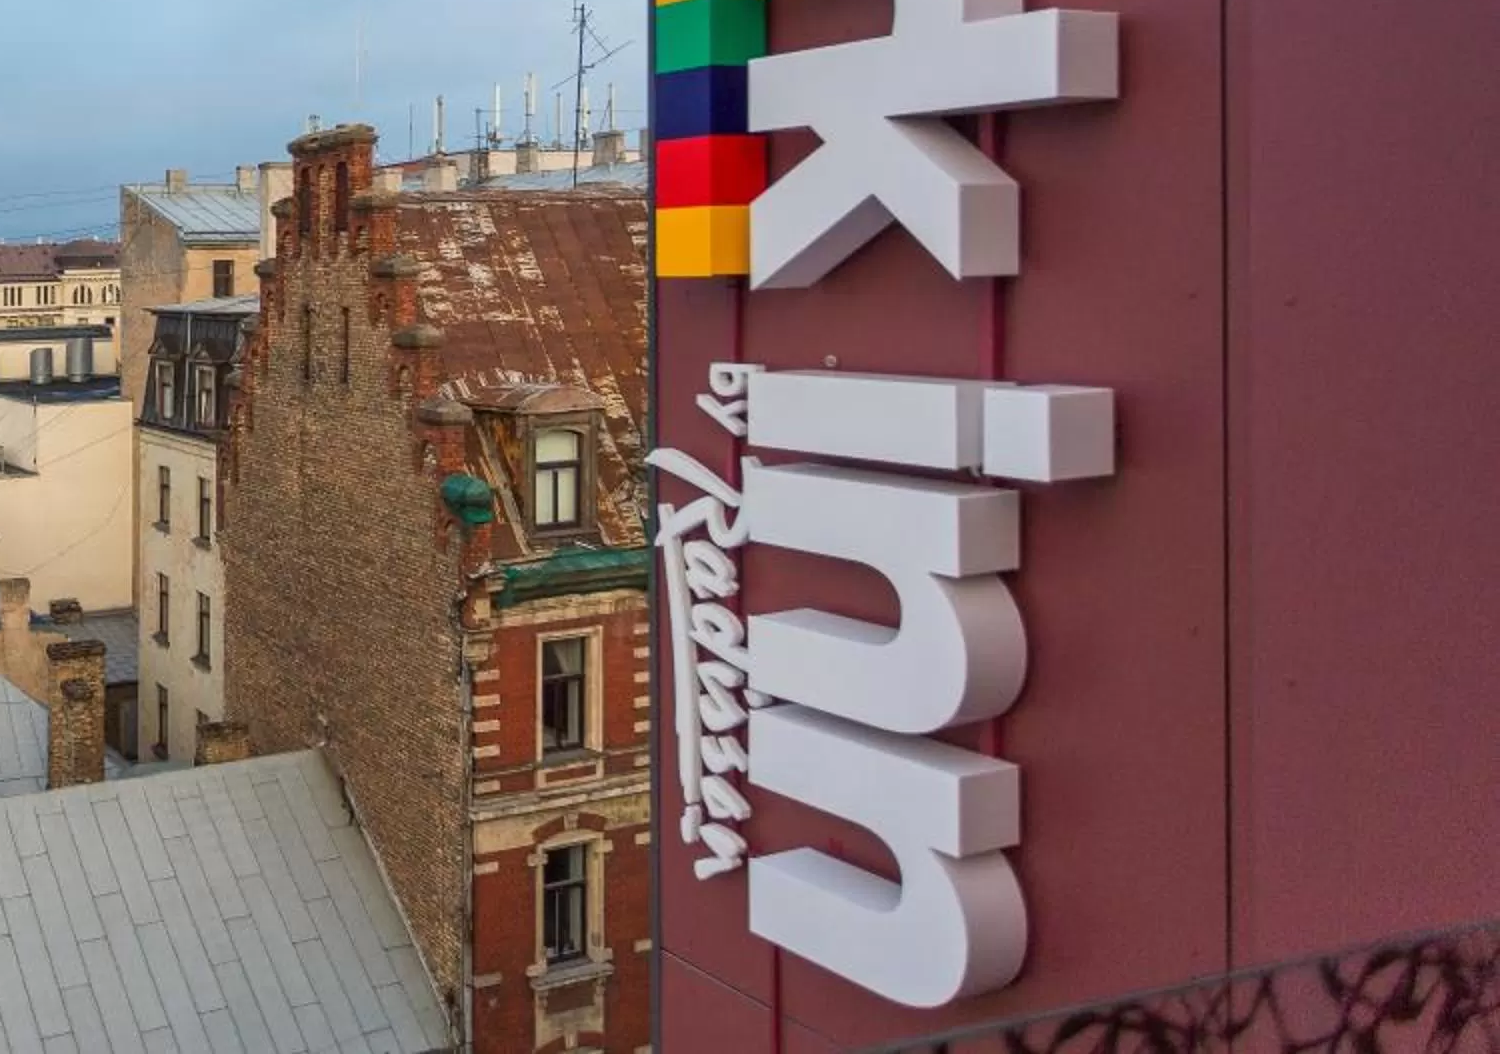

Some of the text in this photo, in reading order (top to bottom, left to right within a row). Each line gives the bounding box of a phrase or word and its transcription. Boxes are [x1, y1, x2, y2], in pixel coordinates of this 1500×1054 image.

[644, 361, 774, 880] by Radisson
[748, 370, 1114, 1007] inn
